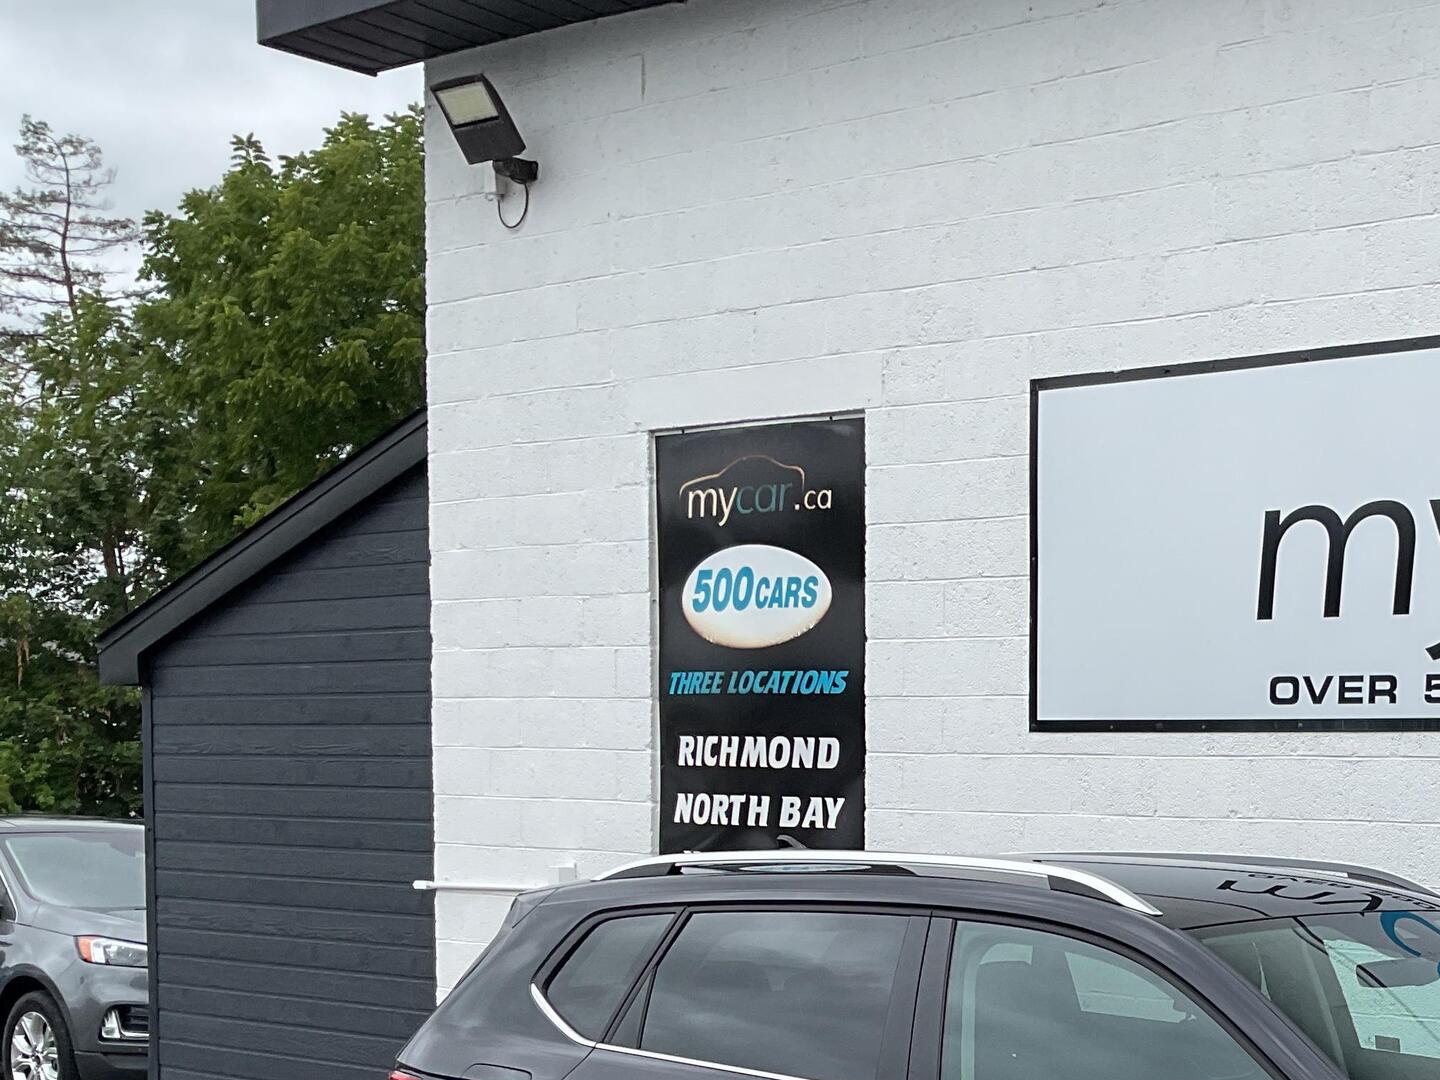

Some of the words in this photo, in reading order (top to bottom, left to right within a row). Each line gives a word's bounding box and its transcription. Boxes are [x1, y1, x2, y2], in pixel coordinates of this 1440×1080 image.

[687, 482, 833, 527] mycar.ca
[692, 566, 755, 614] 500
[755, 576, 819, 610] CARS
[669, 671, 722, 696] THREE
[727, 669, 849, 696] LOCATIONS
[1269, 674, 1398, 705] OVER
[677, 735, 841, 770] RICHMOND
[673, 792, 771, 828] NORTH
[778, 796, 846, 830] BAY
